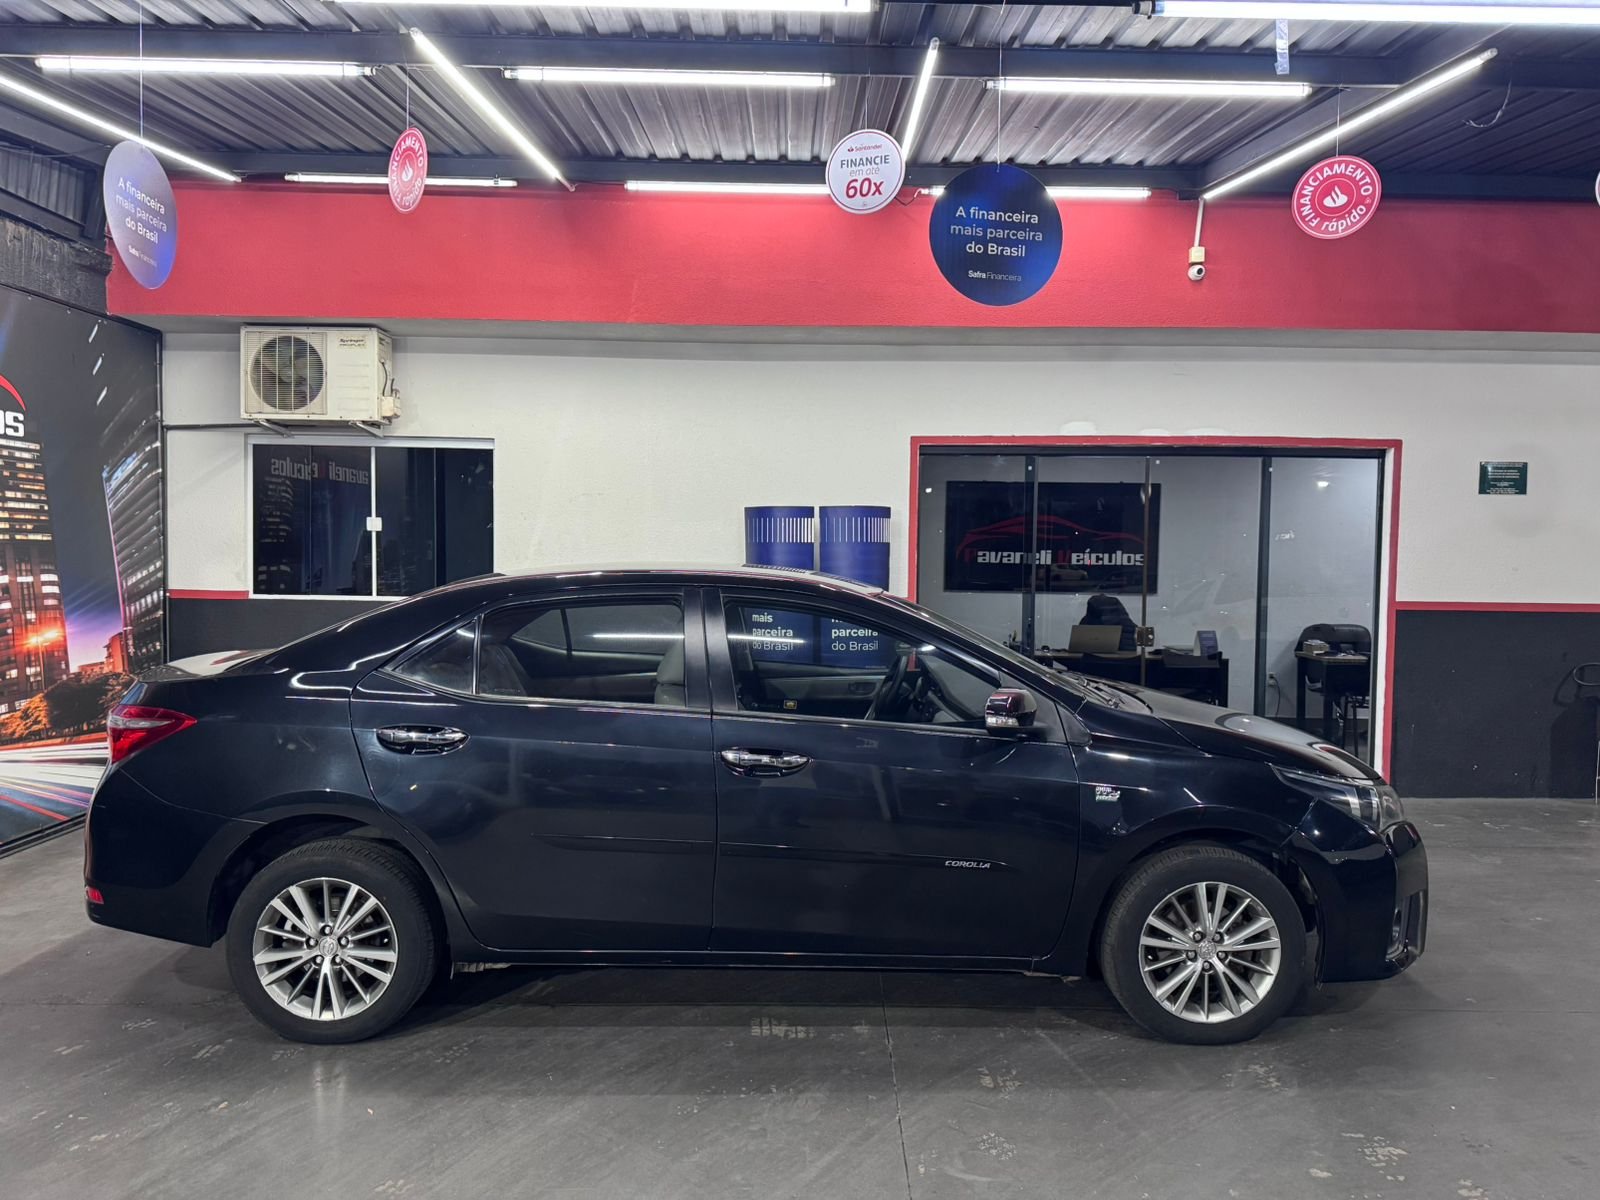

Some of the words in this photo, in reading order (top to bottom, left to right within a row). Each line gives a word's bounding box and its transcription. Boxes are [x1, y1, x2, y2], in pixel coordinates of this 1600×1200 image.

[854, 144, 883, 152] Santander
[840, 154, 890, 168] FINANCIE
[849, 169, 864, 177] em
[865, 167, 880, 177] até
[118, 177, 125, 190] A
[126, 181, 165, 215] financeira
[845, 177, 884, 199] 60x
[1299, 163, 1373, 227] FINANCIAMENTO
[116, 194, 135, 213] mais
[136, 207, 168, 233] parceira
[955, 206, 967, 218] A
[969, 207, 1039, 224] financeira
[1321, 205, 1366, 233] rápido
[125, 216, 136, 231] do
[137, 223, 159, 245] Brasil
[950, 224, 983, 236] mais
[986, 228, 1043, 241] parceira
[966, 241, 984, 254] do
[987, 243, 1026, 257] Brasil
[752, 612, 773, 623] mais
[752, 627, 794, 638] parceira
[764, 640, 794, 651] Brasil
[831, 640, 846, 651] do
[849, 640, 879, 651] Brasil
[944, 860, 991, 869] COROLLA
